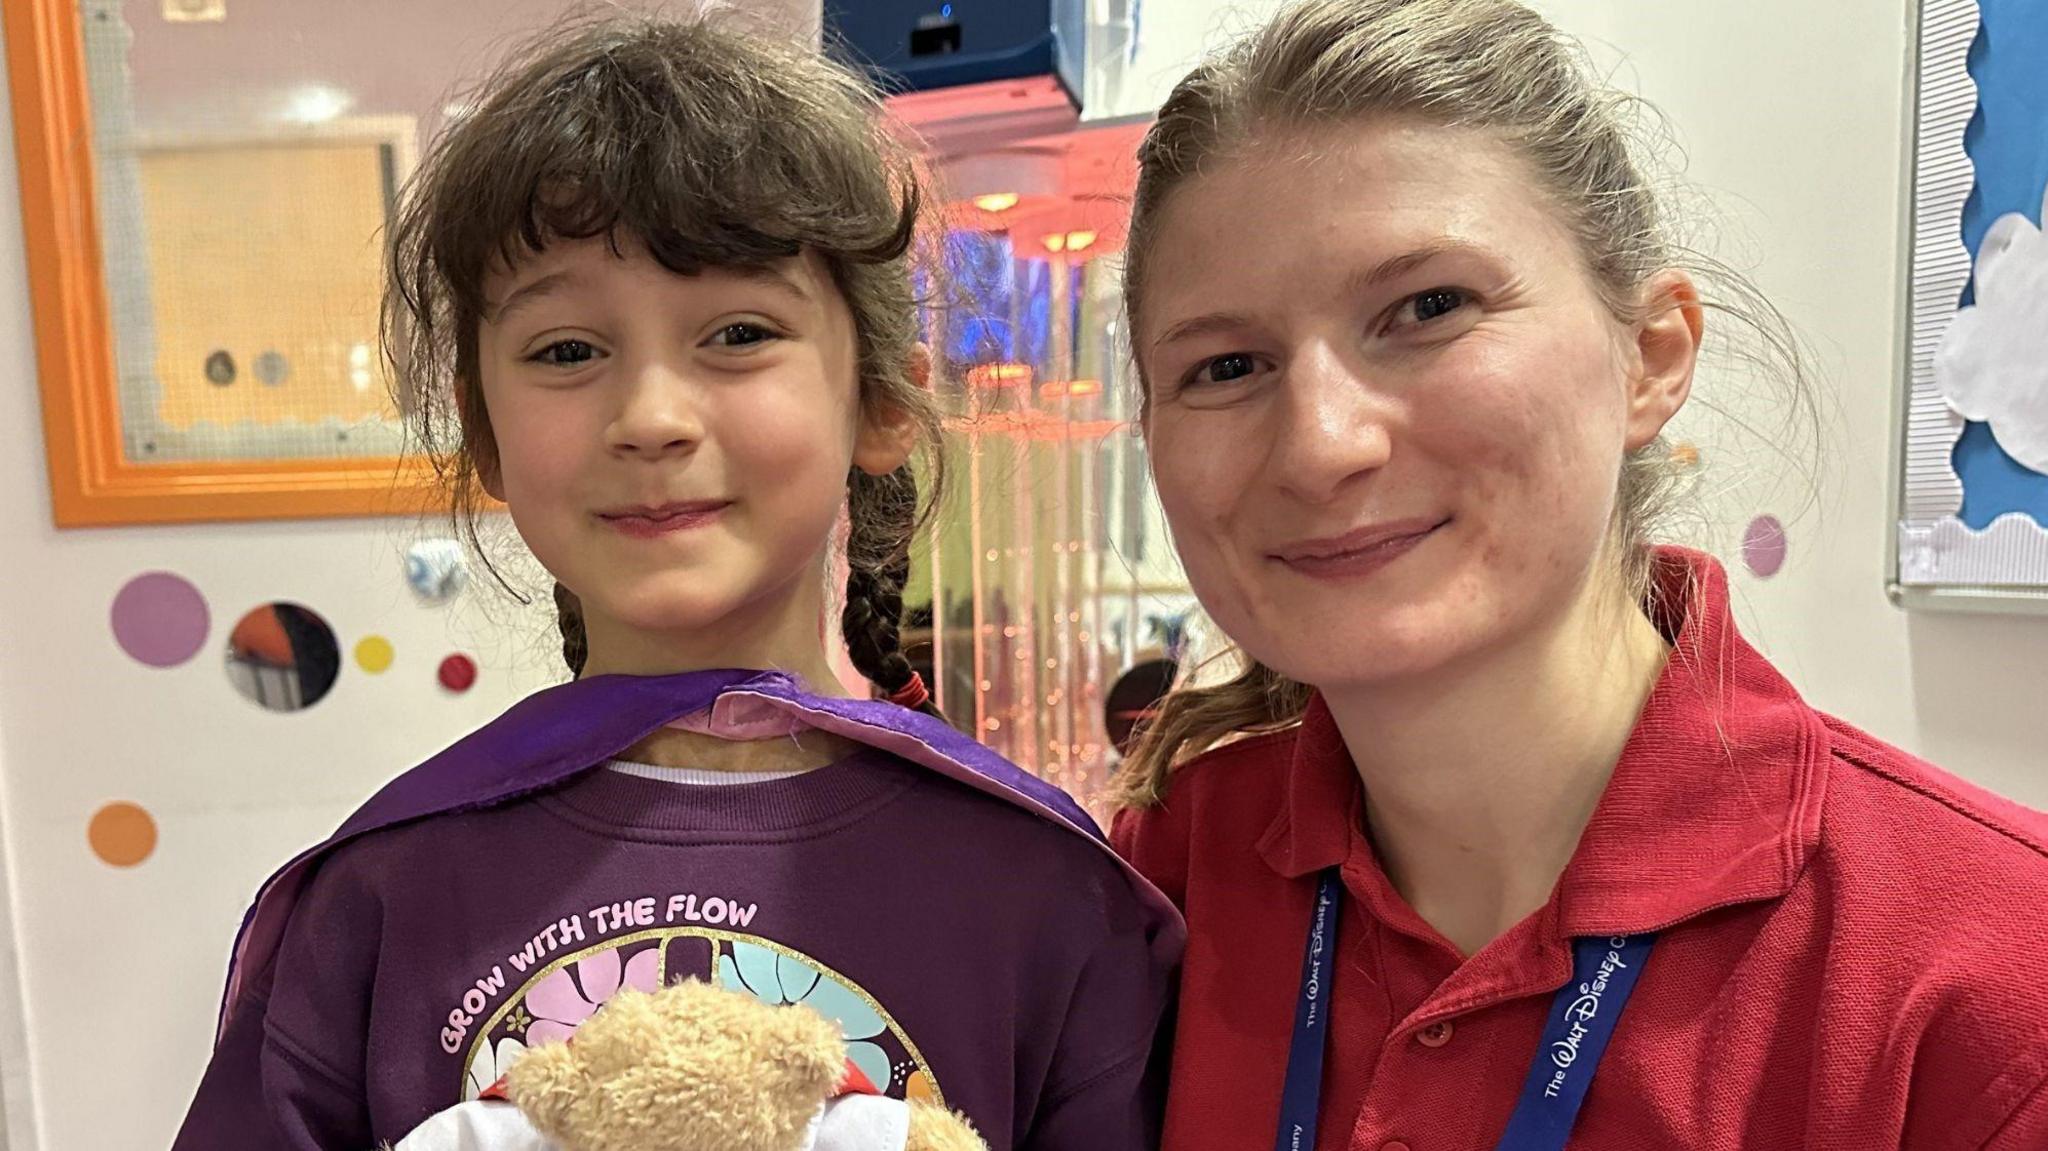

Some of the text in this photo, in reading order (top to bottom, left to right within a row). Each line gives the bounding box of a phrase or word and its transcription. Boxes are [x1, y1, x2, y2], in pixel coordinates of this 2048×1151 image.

[440, 893, 758, 1054] GROW WITH THE FLOW
[1306, 1002, 1317, 1029] The
[1544, 1070, 1567, 1098] The
